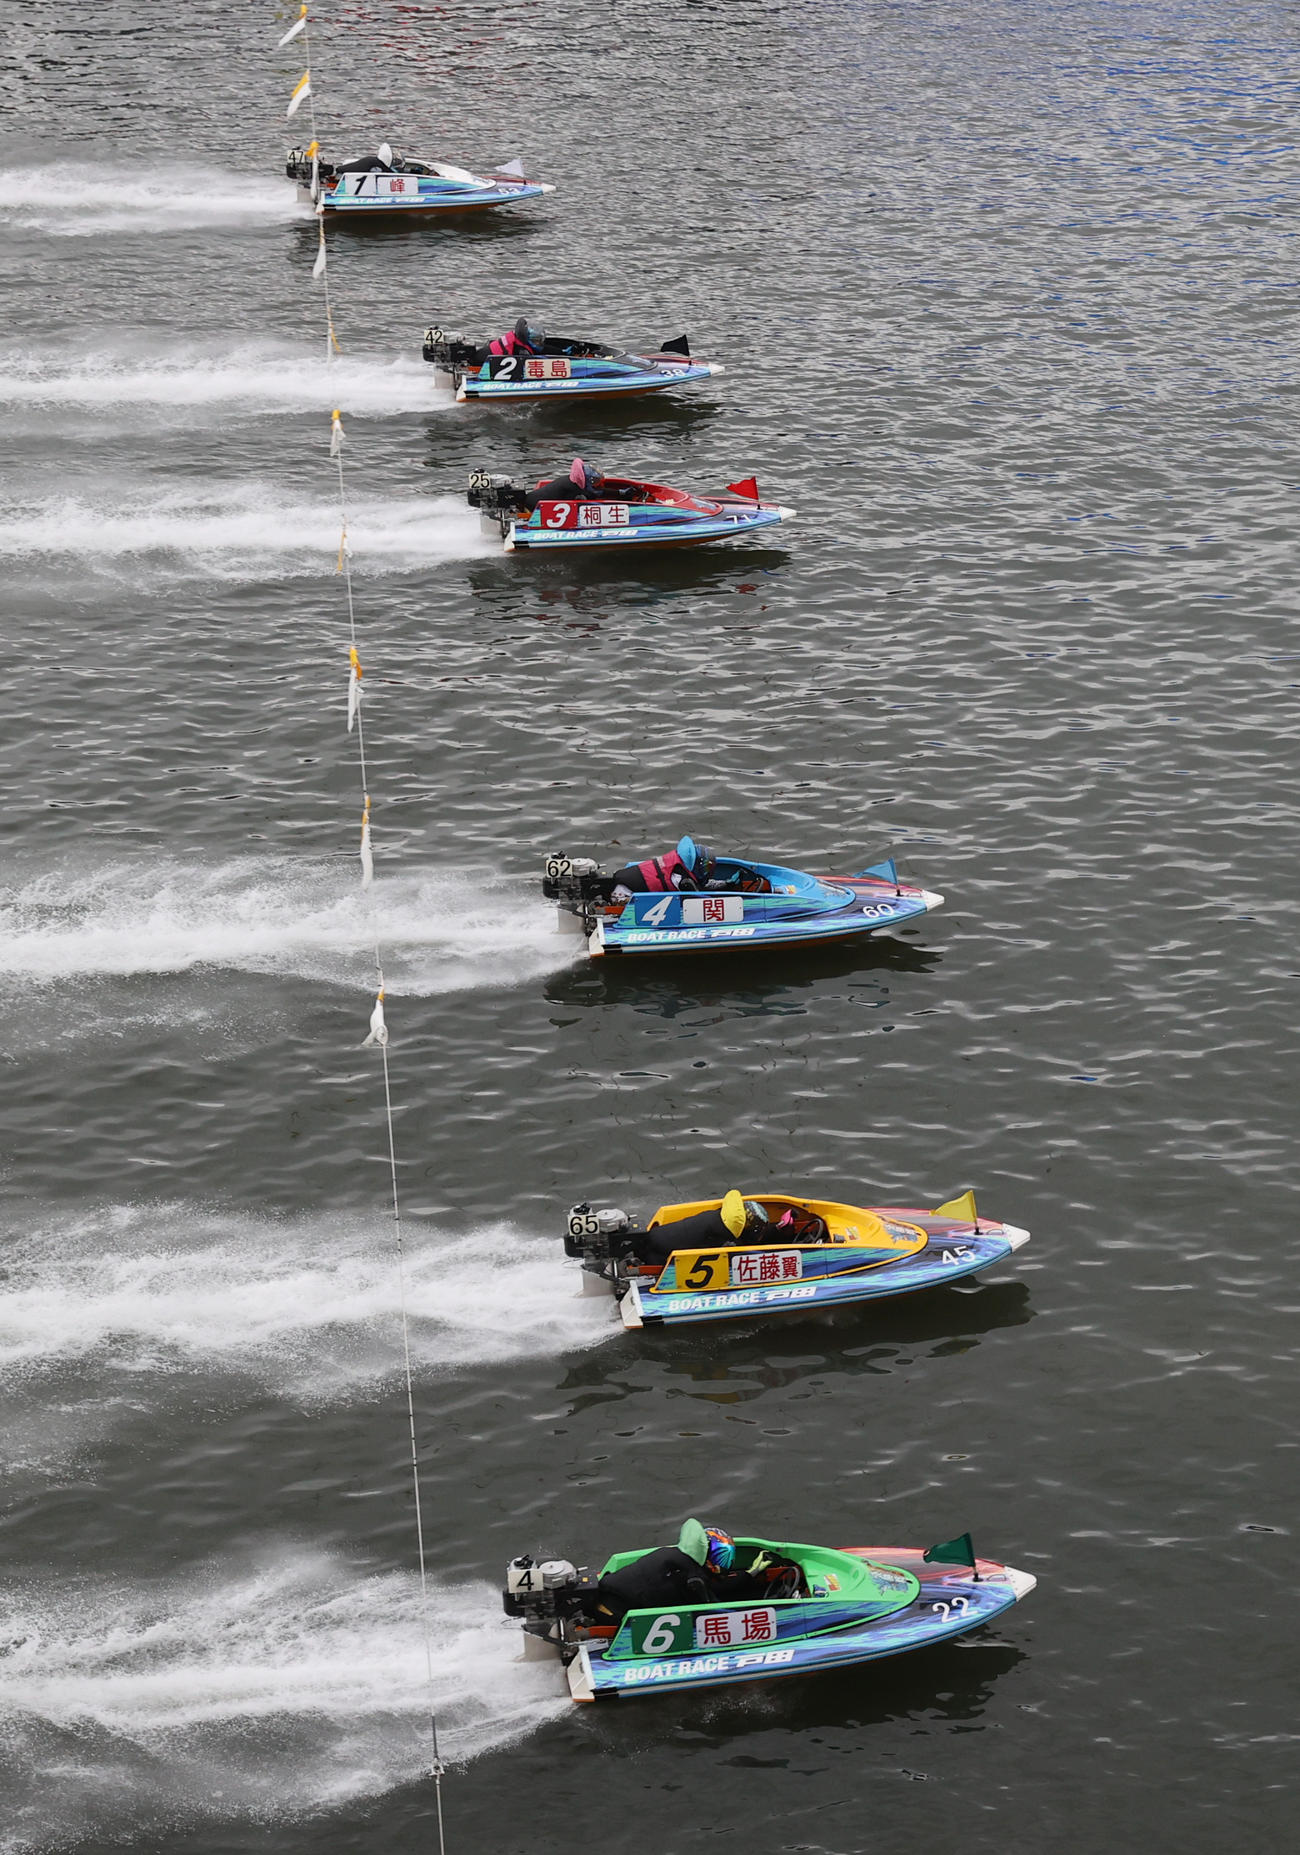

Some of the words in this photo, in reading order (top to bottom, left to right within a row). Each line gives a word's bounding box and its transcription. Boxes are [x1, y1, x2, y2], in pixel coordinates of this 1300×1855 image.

[354, 175, 368, 195] 1
[390, 178, 406, 193] 峰
[425, 330, 443, 344] 42
[493, 357, 517, 380] 2
[527, 360, 568, 378] 毒島
[470, 474, 490, 488] 25
[546, 503, 571, 528] 3
[583, 506, 626, 525] 桐生
[726, 514, 752, 525] 71
[534, 531, 566, 540] BOAT
[566, 530, 599, 538] RACE
[547, 860, 572, 878] 62
[641, 895, 674, 926] 4
[703, 899, 725, 922] 関
[862, 903, 894, 918] 60
[628, 931, 670, 942] BOAT
[668, 929, 707, 940] RACE
[569, 1215, 599, 1235] 65
[941, 1245, 976, 1266] 45
[685, 1254, 720, 1289] 5
[737, 1253, 799, 1282] 佐藤翼
[668, 1295, 719, 1311] BOAT
[718, 1291, 761, 1306] RACE
[764, 1286, 817, 1301] 戸田
[516, 1570, 534, 1591] 4
[932, 1597, 978, 1623] 22
[642, 1614, 681, 1654] 6
[703, 1610, 772, 1645] 馬場
[624, 1664, 677, 1682] BOAT
[678, 1656, 730, 1675] RACE
[733, 1649, 795, 1668] 戸田
